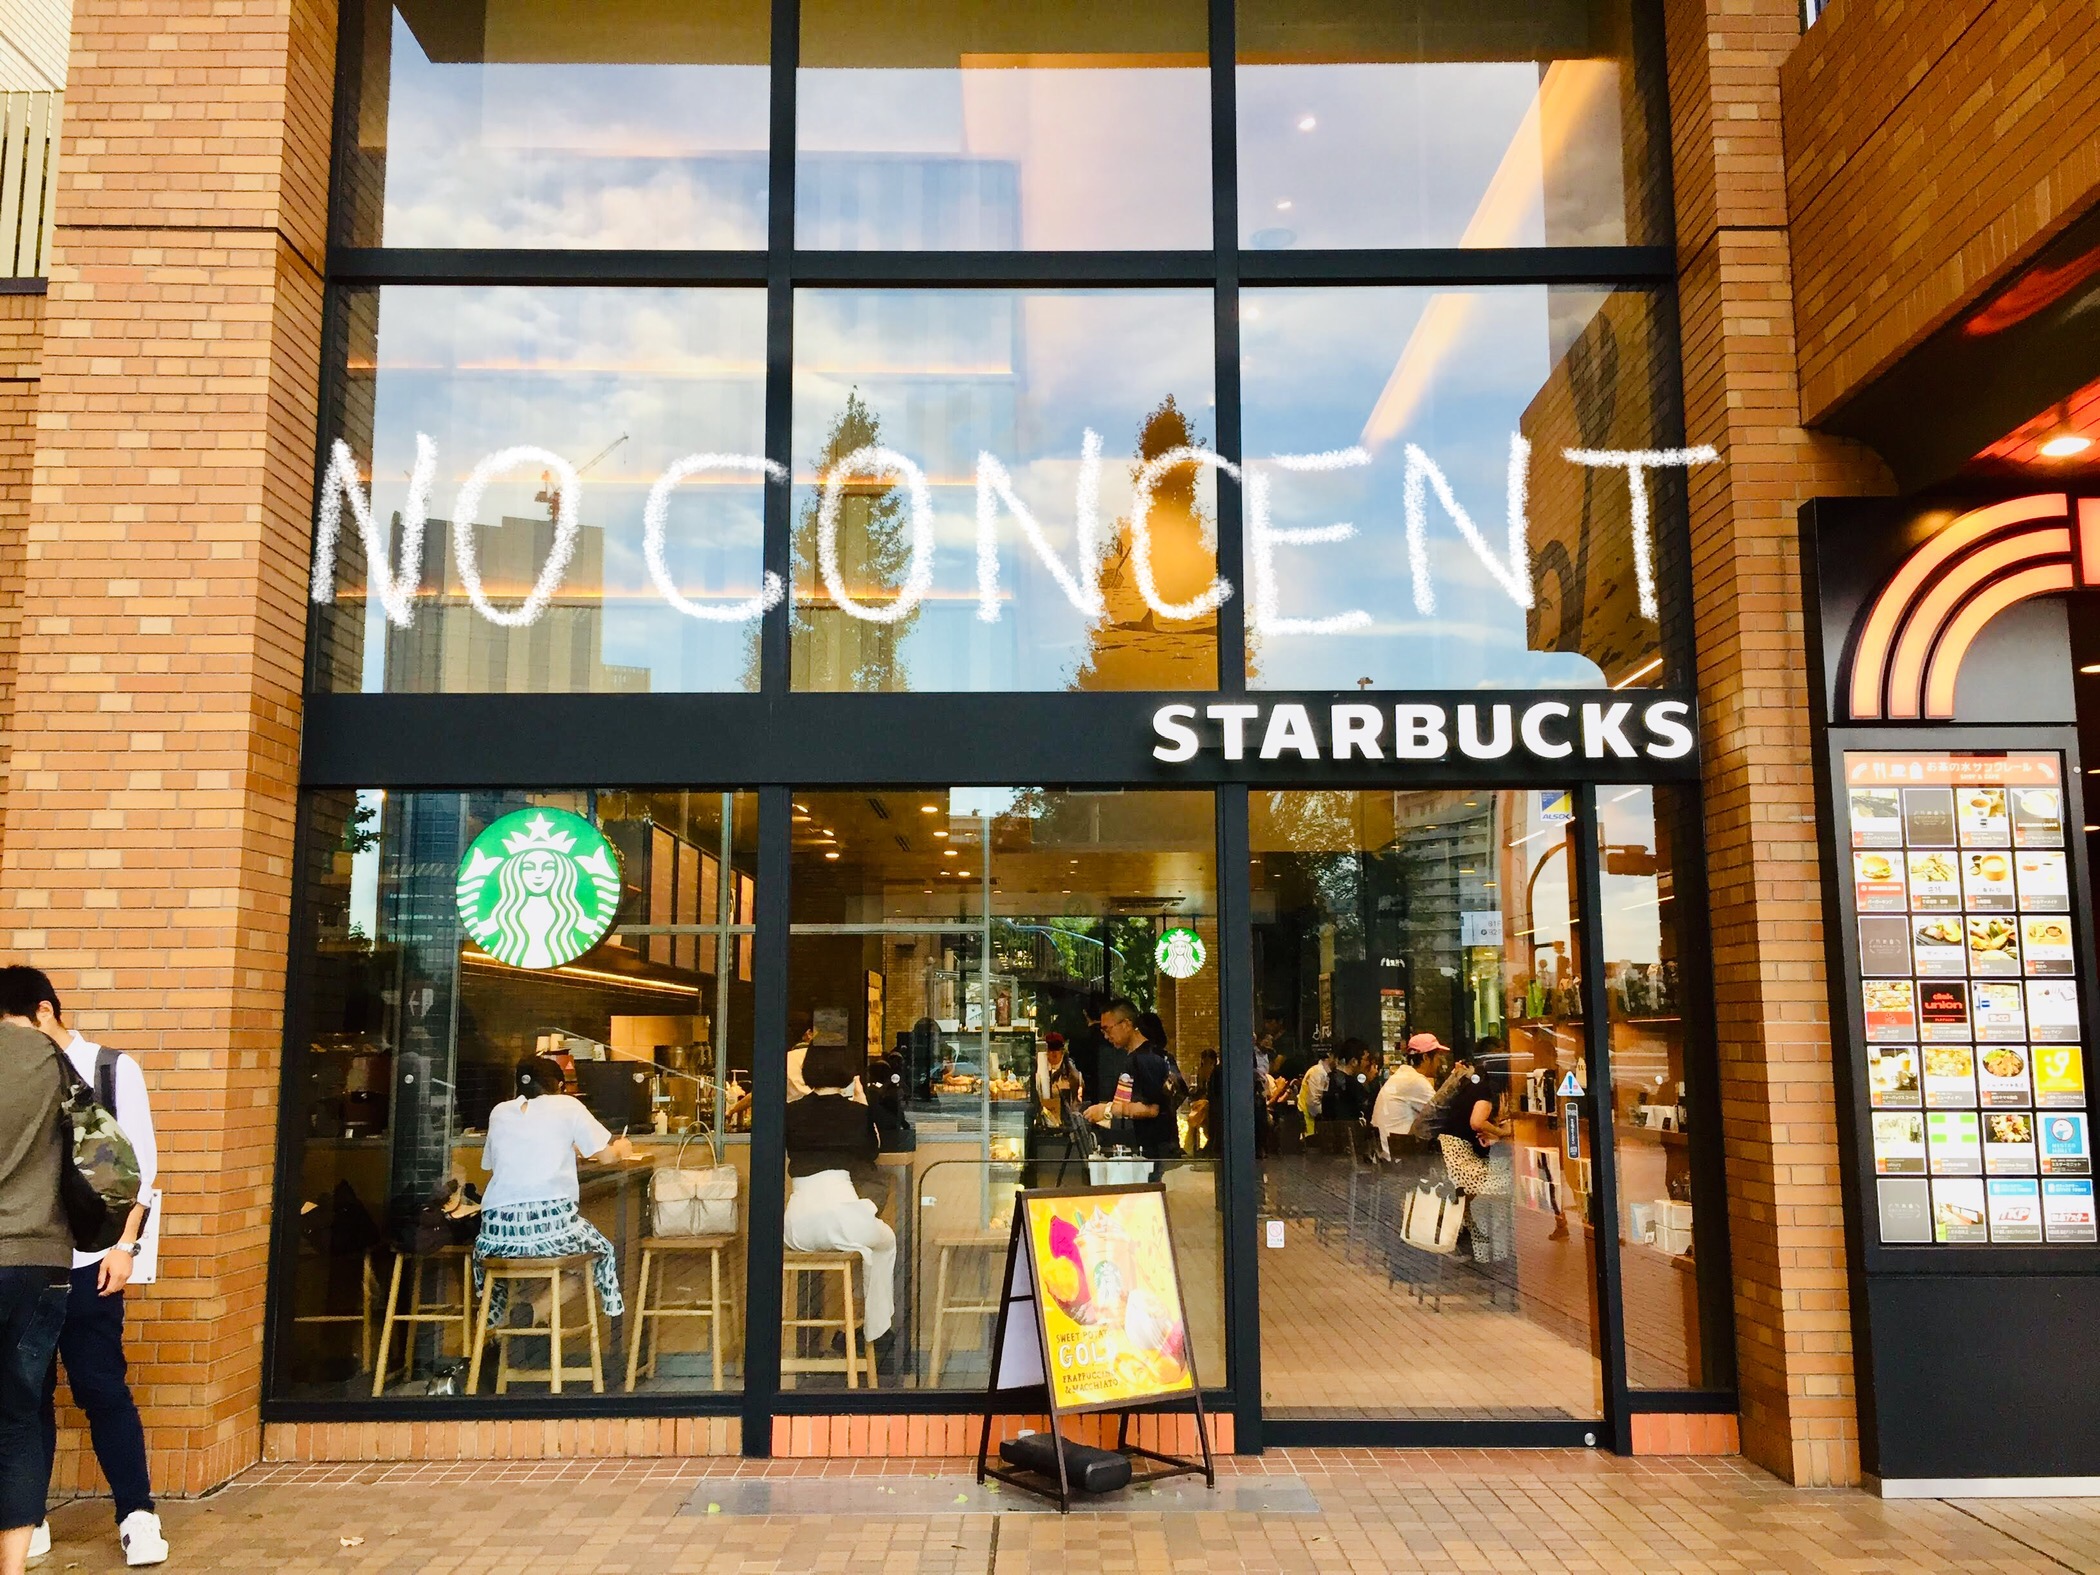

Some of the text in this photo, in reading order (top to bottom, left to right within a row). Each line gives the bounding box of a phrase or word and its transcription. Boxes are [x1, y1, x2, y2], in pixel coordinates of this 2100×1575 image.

[1152, 701, 1694, 763] STARBUCKS
[1932, 992, 1954, 1000] disk
[1924, 1000, 1963, 1009] union
[1056, 1329, 1112, 1344] SWEET POAT
